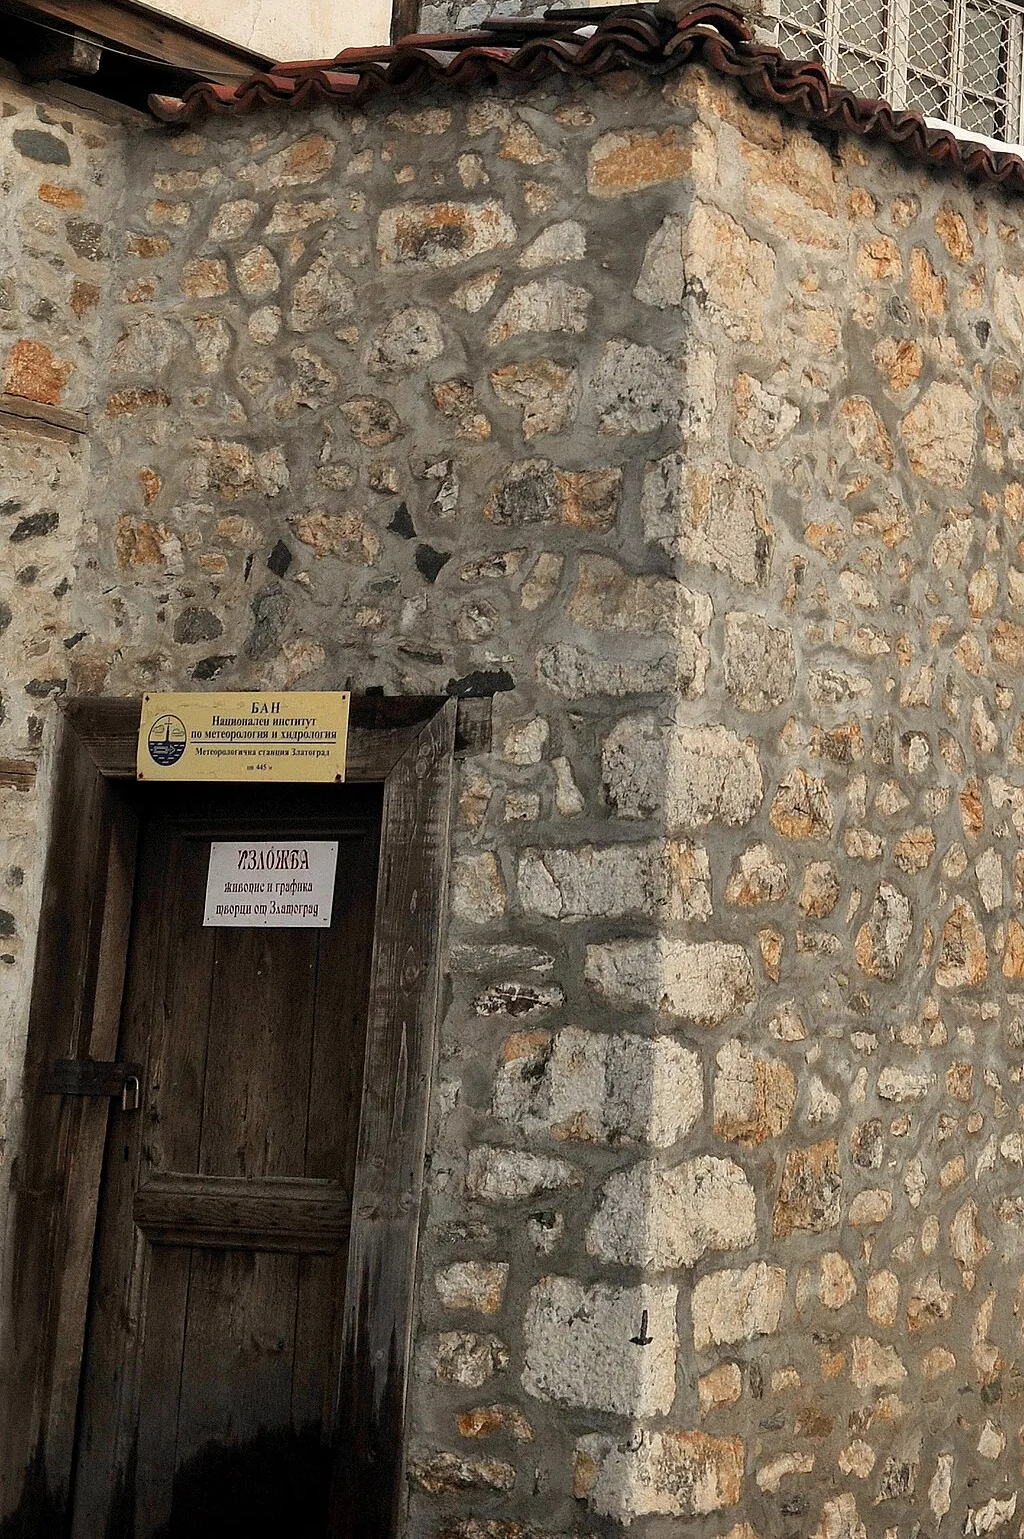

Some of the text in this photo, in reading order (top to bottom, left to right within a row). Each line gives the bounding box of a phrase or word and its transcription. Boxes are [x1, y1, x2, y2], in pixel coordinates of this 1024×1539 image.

[251, 701, 281, 714] БАН
[212, 715, 316, 729] Национален институт
[191, 730, 337, 741] по метеорология и хидрология
[195, 747, 330, 758] Метеорологична станция Златоград
[237, 848, 310, 870] ИЗЛОЖБА
[224, 878, 313, 896] живопис и графика
[216, 900, 320, 918] творци от Златоград
